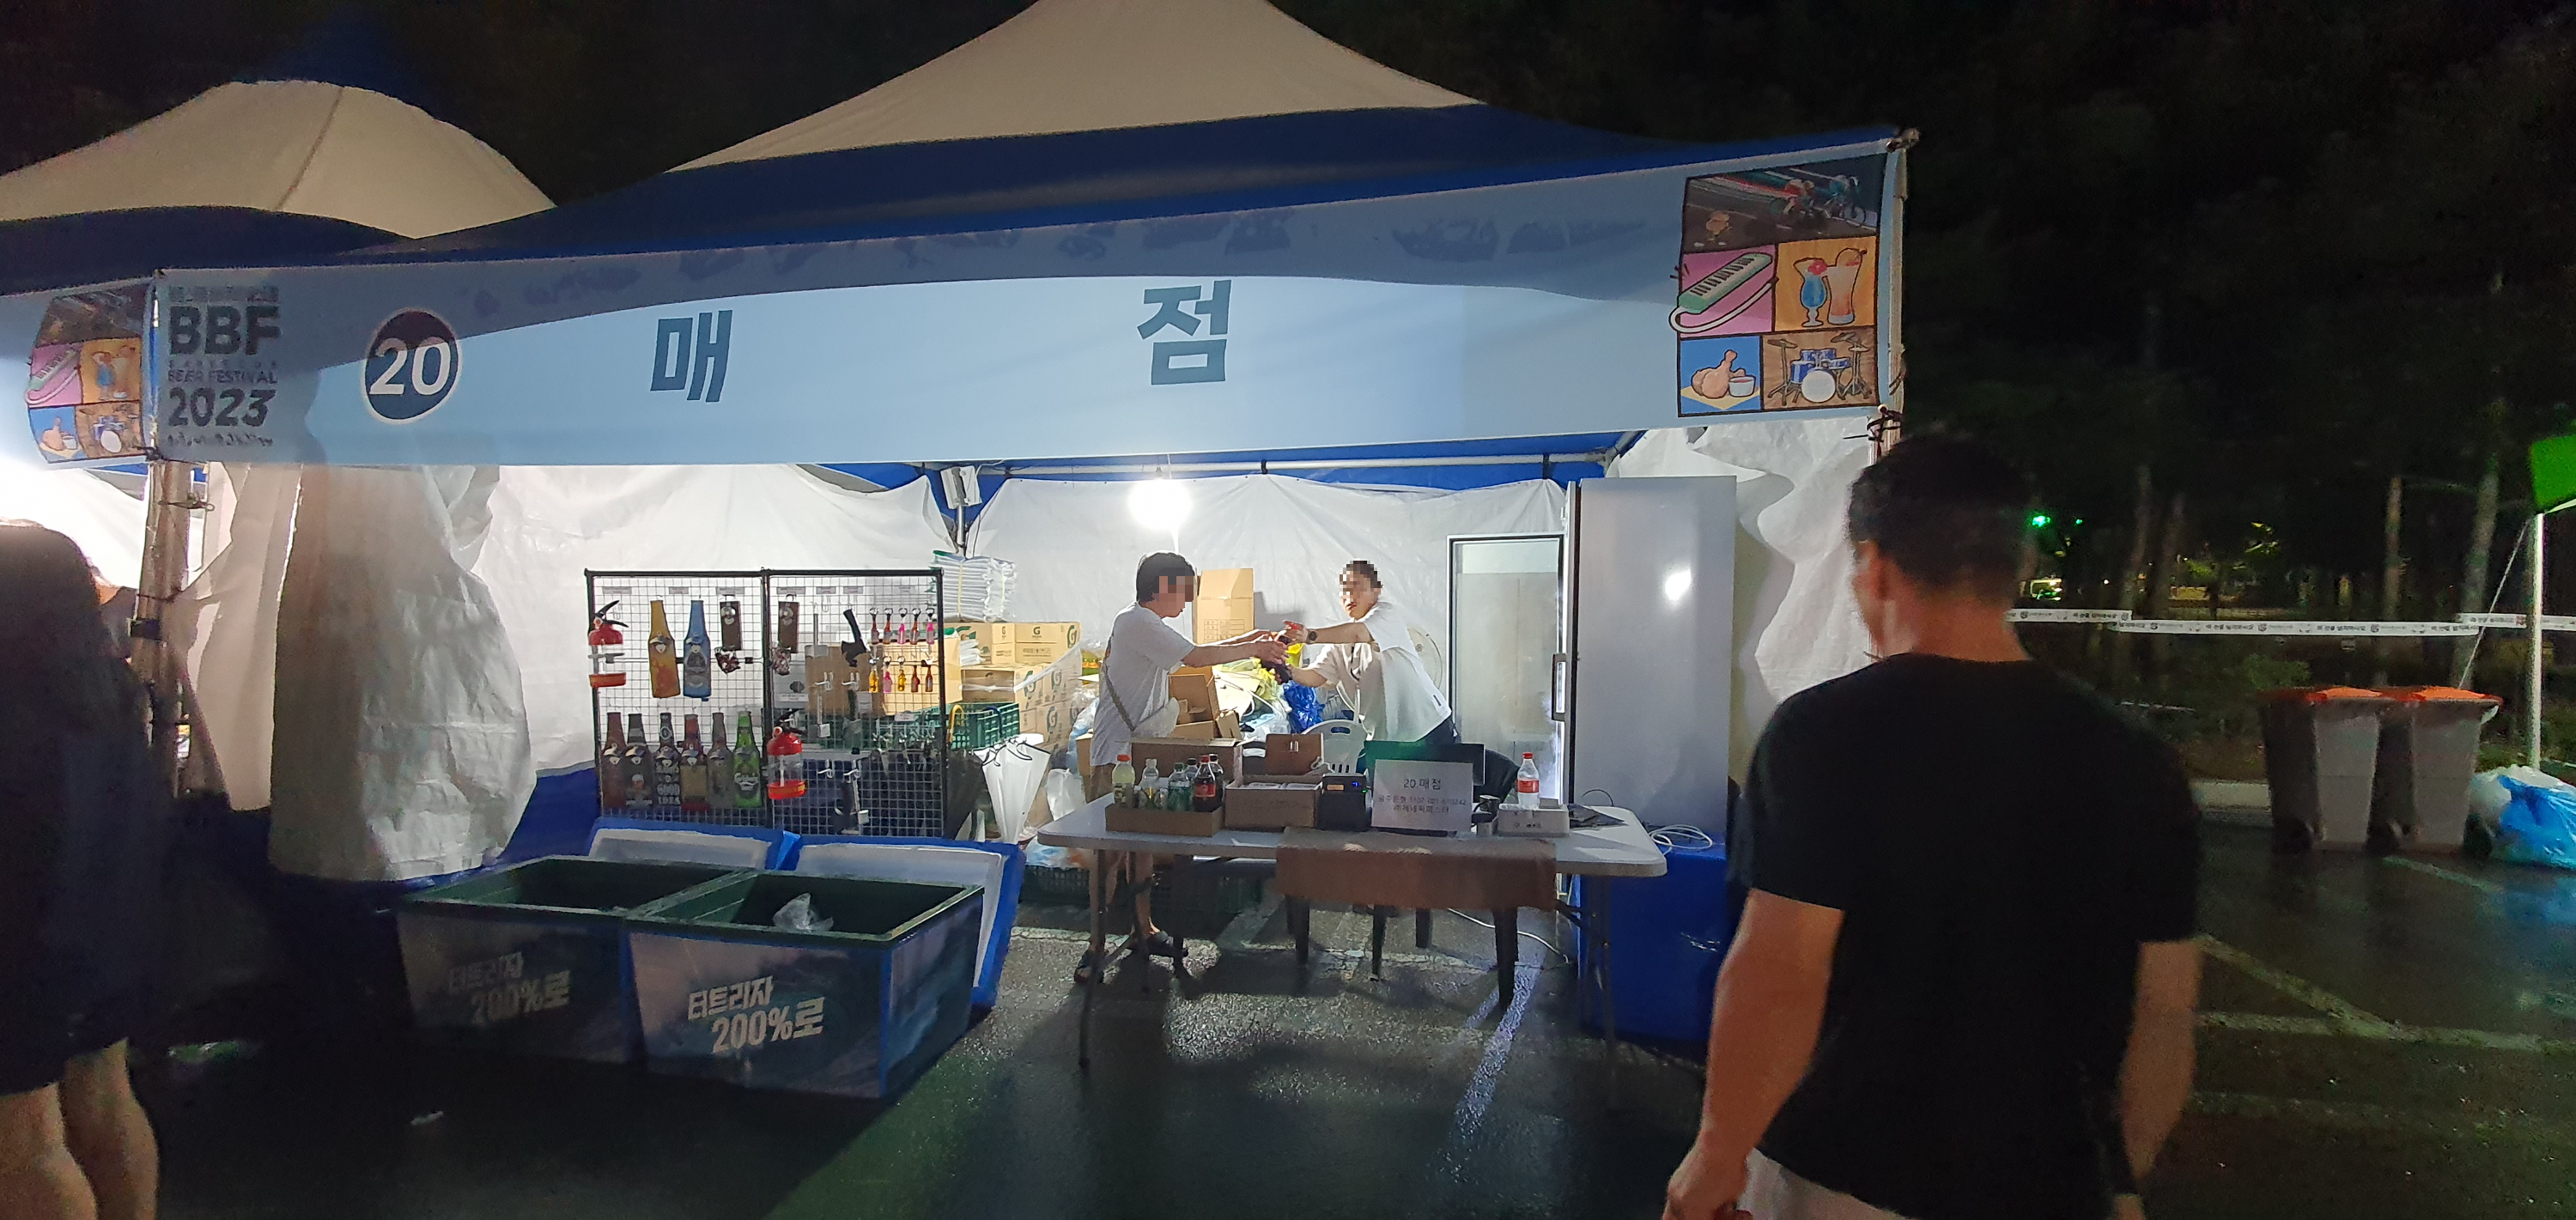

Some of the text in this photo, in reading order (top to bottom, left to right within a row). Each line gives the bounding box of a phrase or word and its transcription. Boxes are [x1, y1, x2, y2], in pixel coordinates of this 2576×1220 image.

[169, 305, 282, 355] BBF
[650, 280, 1232, 403] 매 점
[167, 369, 278, 385] BEER FESTIVAL
[368, 337, 452, 396] 20
[168, 386, 277, 428] 2023
[712, 996, 825, 1054] 200%로
